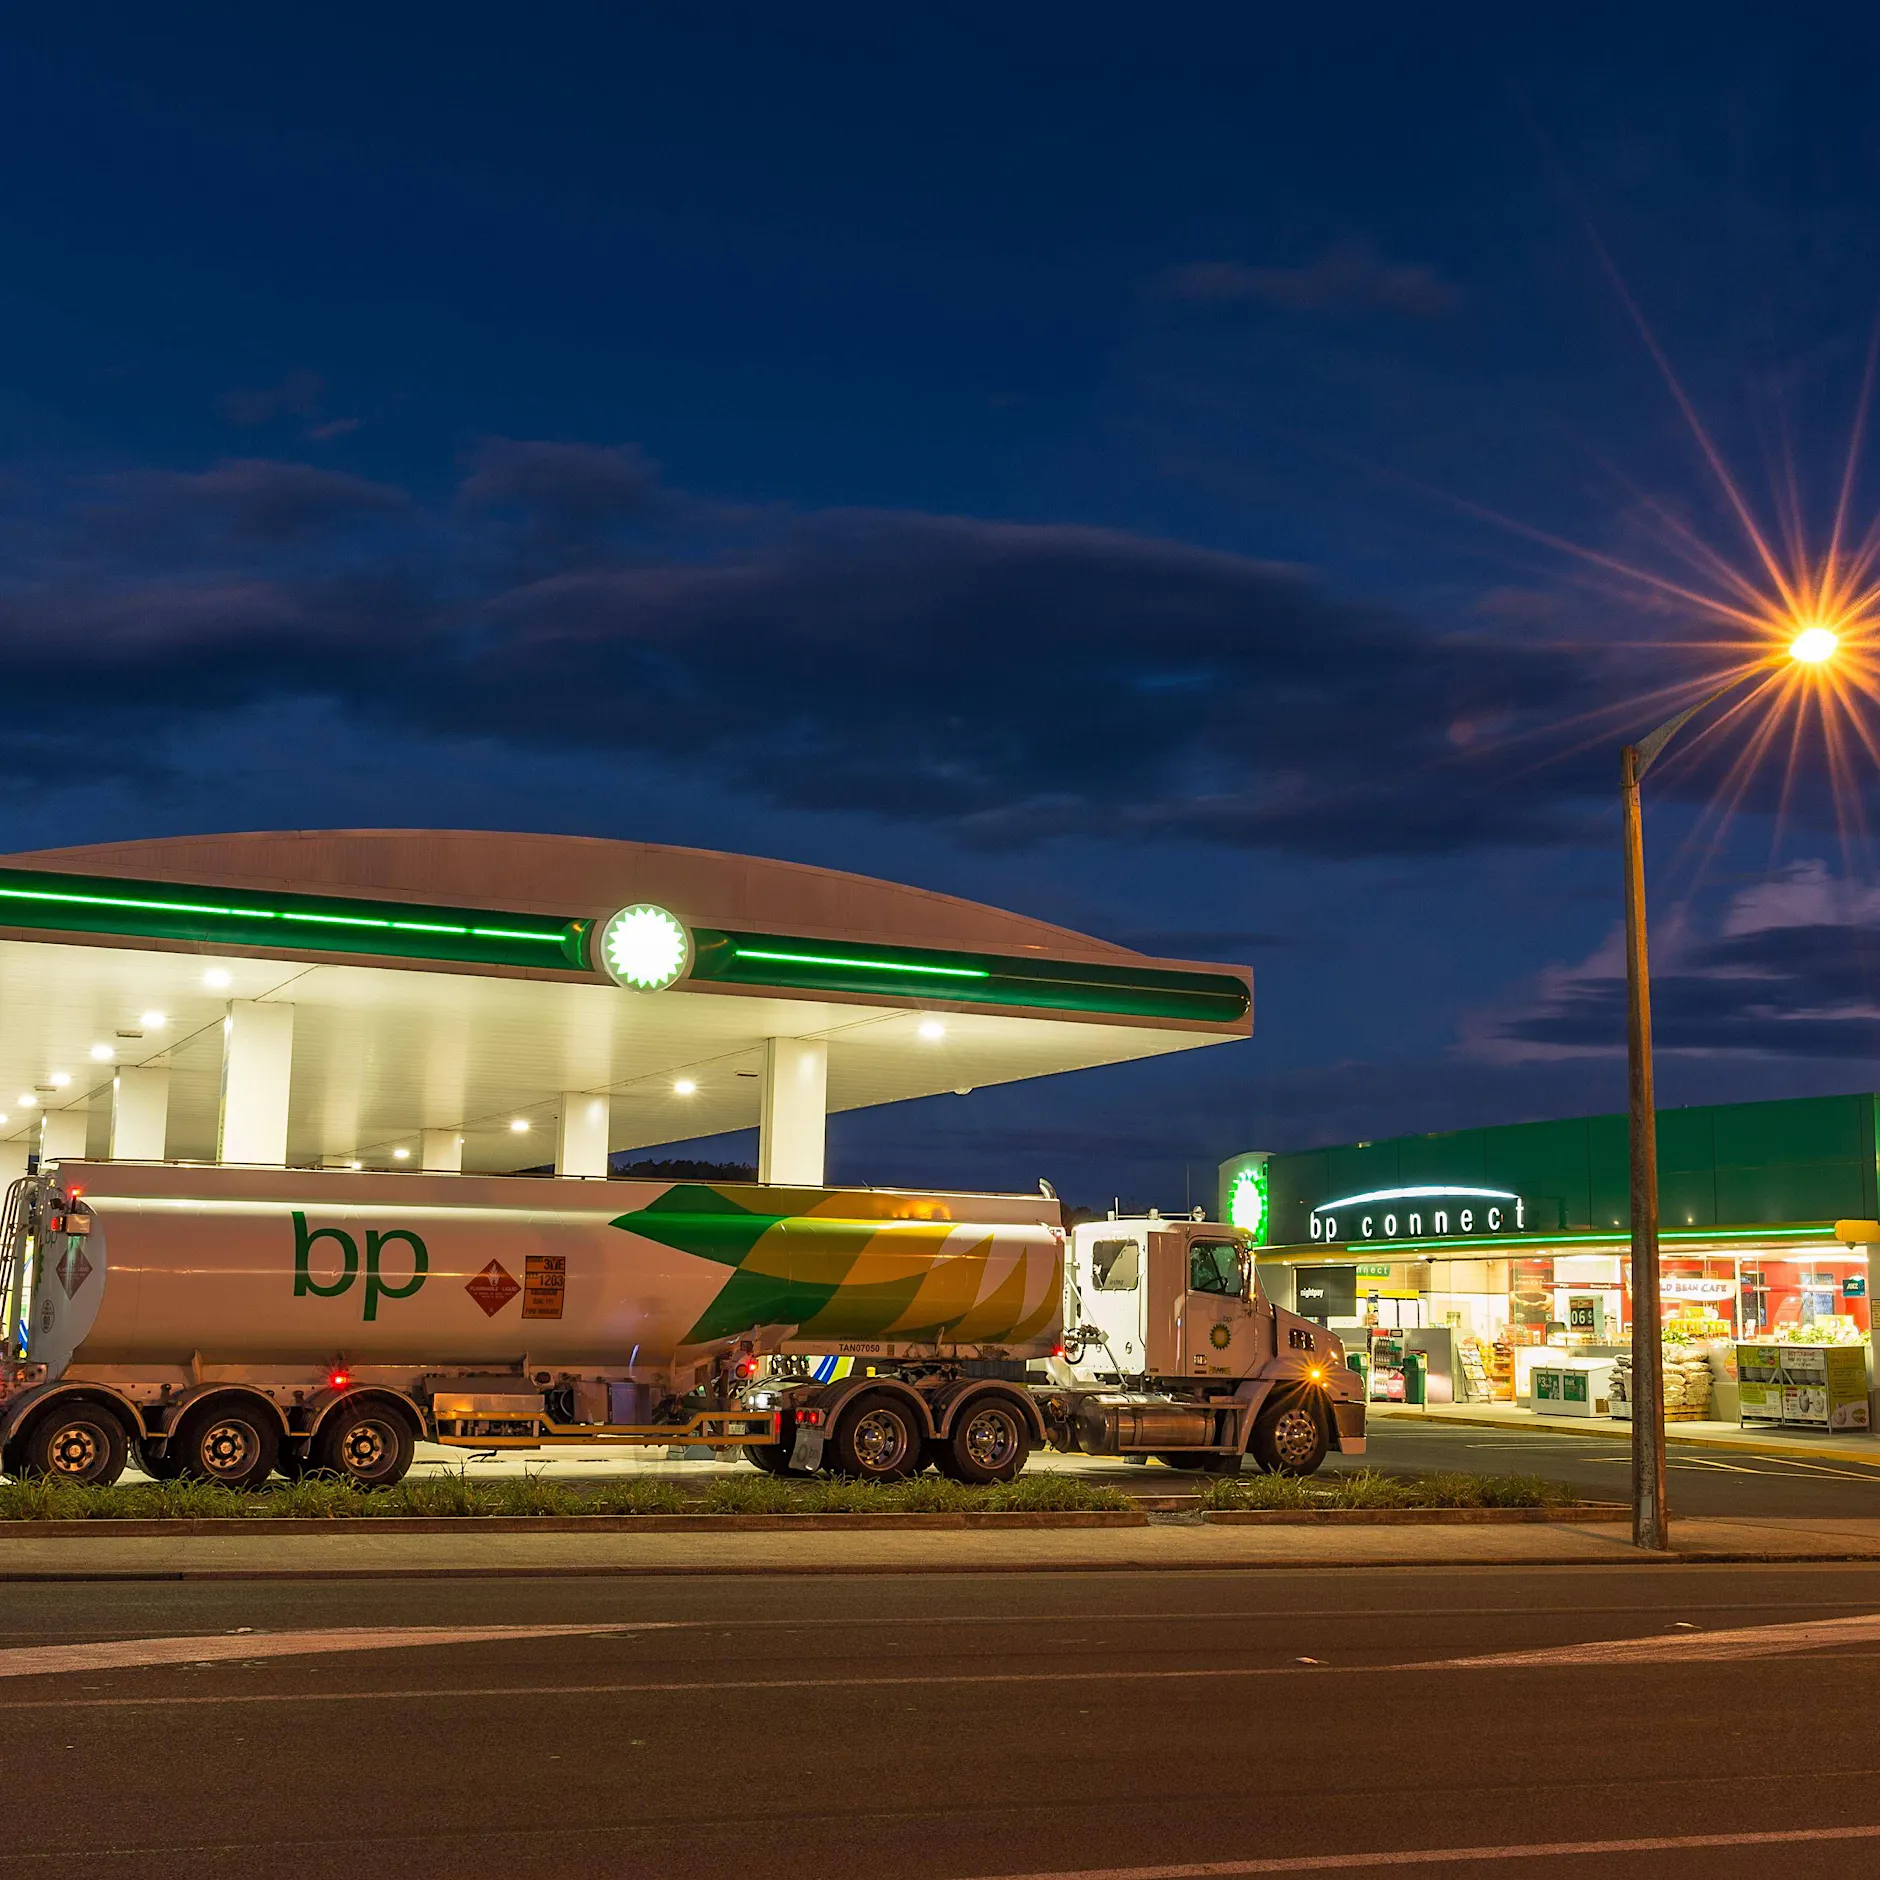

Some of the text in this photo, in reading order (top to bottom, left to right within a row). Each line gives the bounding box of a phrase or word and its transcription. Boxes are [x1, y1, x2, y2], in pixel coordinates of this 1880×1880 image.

[1310, 1198, 1525, 1243] bp connect
[291, 1211, 429, 1321] bp
[540, 1274, 563, 1286] 1203
[1300, 1288, 1324, 1299] nightpay
[1676, 1284, 1698, 1292] BEAN
[1701, 1284, 1727, 1292] CAFE
[1571, 1310, 1585, 1325] 06
[839, 1343, 880, 1352] TAN07050
